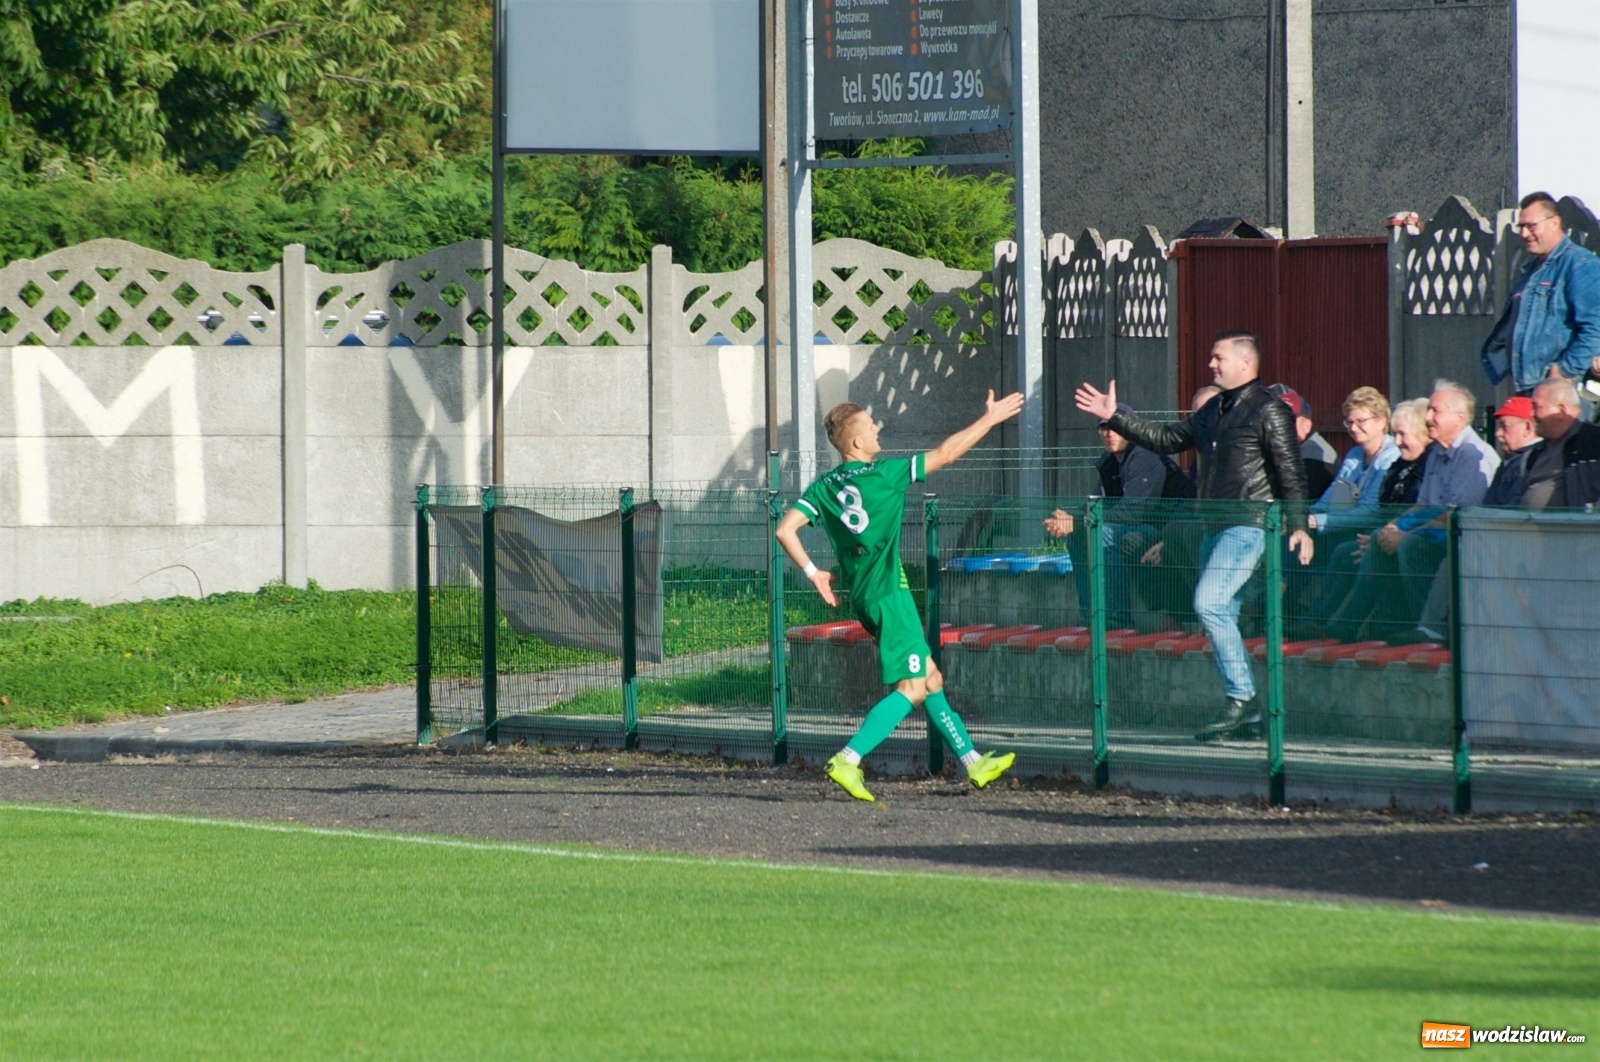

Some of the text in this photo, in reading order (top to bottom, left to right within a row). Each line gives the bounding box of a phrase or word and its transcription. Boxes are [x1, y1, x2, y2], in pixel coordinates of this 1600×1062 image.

[835, 10, 869, 24] Dostawcze
[918, 7, 943, 23] Lawety
[836, 27, 872, 41] Autolaweta
[920, 24, 929, 37] Do
[930, 25, 968, 40] przewozu
[836, 44, 903, 61] Przyczepy towarowe
[920, 40, 958, 58] Wywrotka
[841, 68, 984, 104] tel. 506 501 396
[865, 110, 876, 125] ul.
[923, 104, 1000, 124] www.kam-mad.pl
[836, 485, 870, 535] 8
[908, 653, 921, 674] 8
